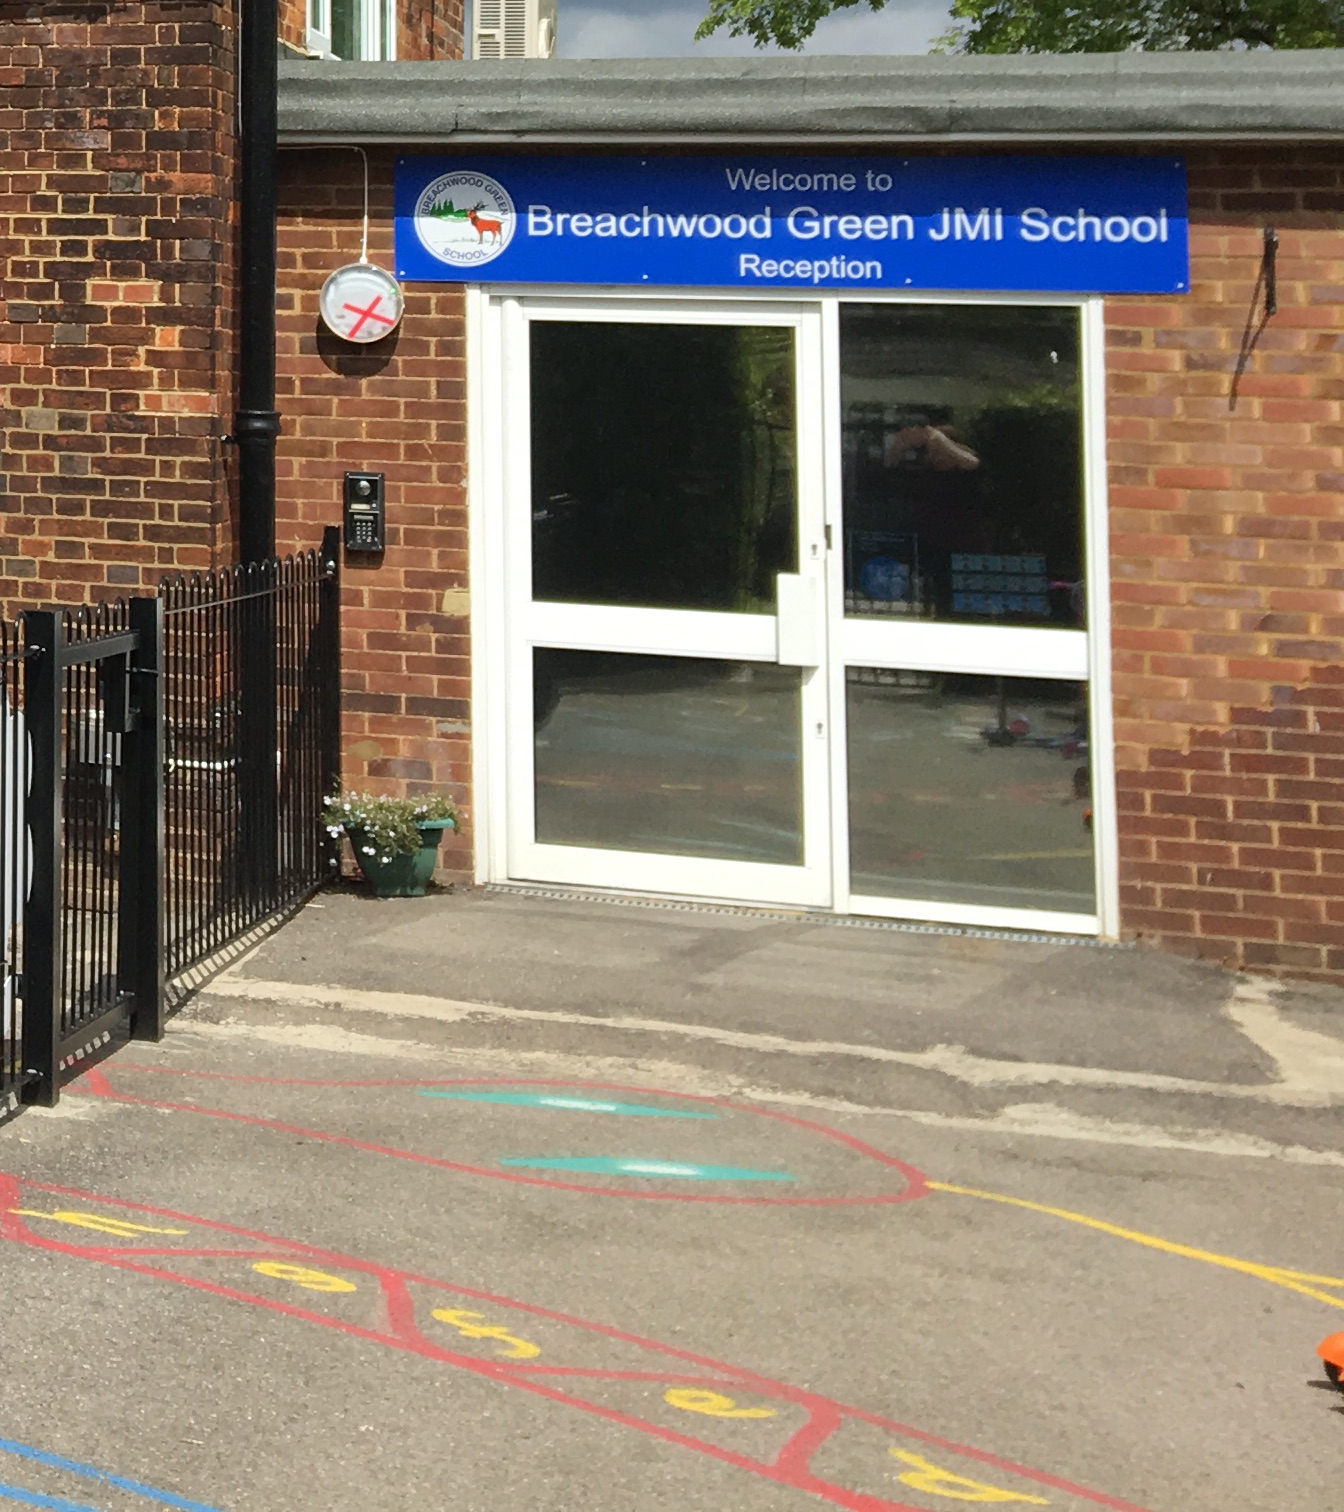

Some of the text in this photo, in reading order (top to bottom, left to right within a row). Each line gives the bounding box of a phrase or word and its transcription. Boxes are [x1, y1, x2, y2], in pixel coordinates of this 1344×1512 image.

[725, 167, 893, 192] Welcome to
[421, 176, 510, 216] BREACHWOOD GREEN
[527, 205, 1169, 244] Breachwood Green JMI School
[442, 247, 488, 261] SCHOOL
[738, 253, 883, 285] Reception
